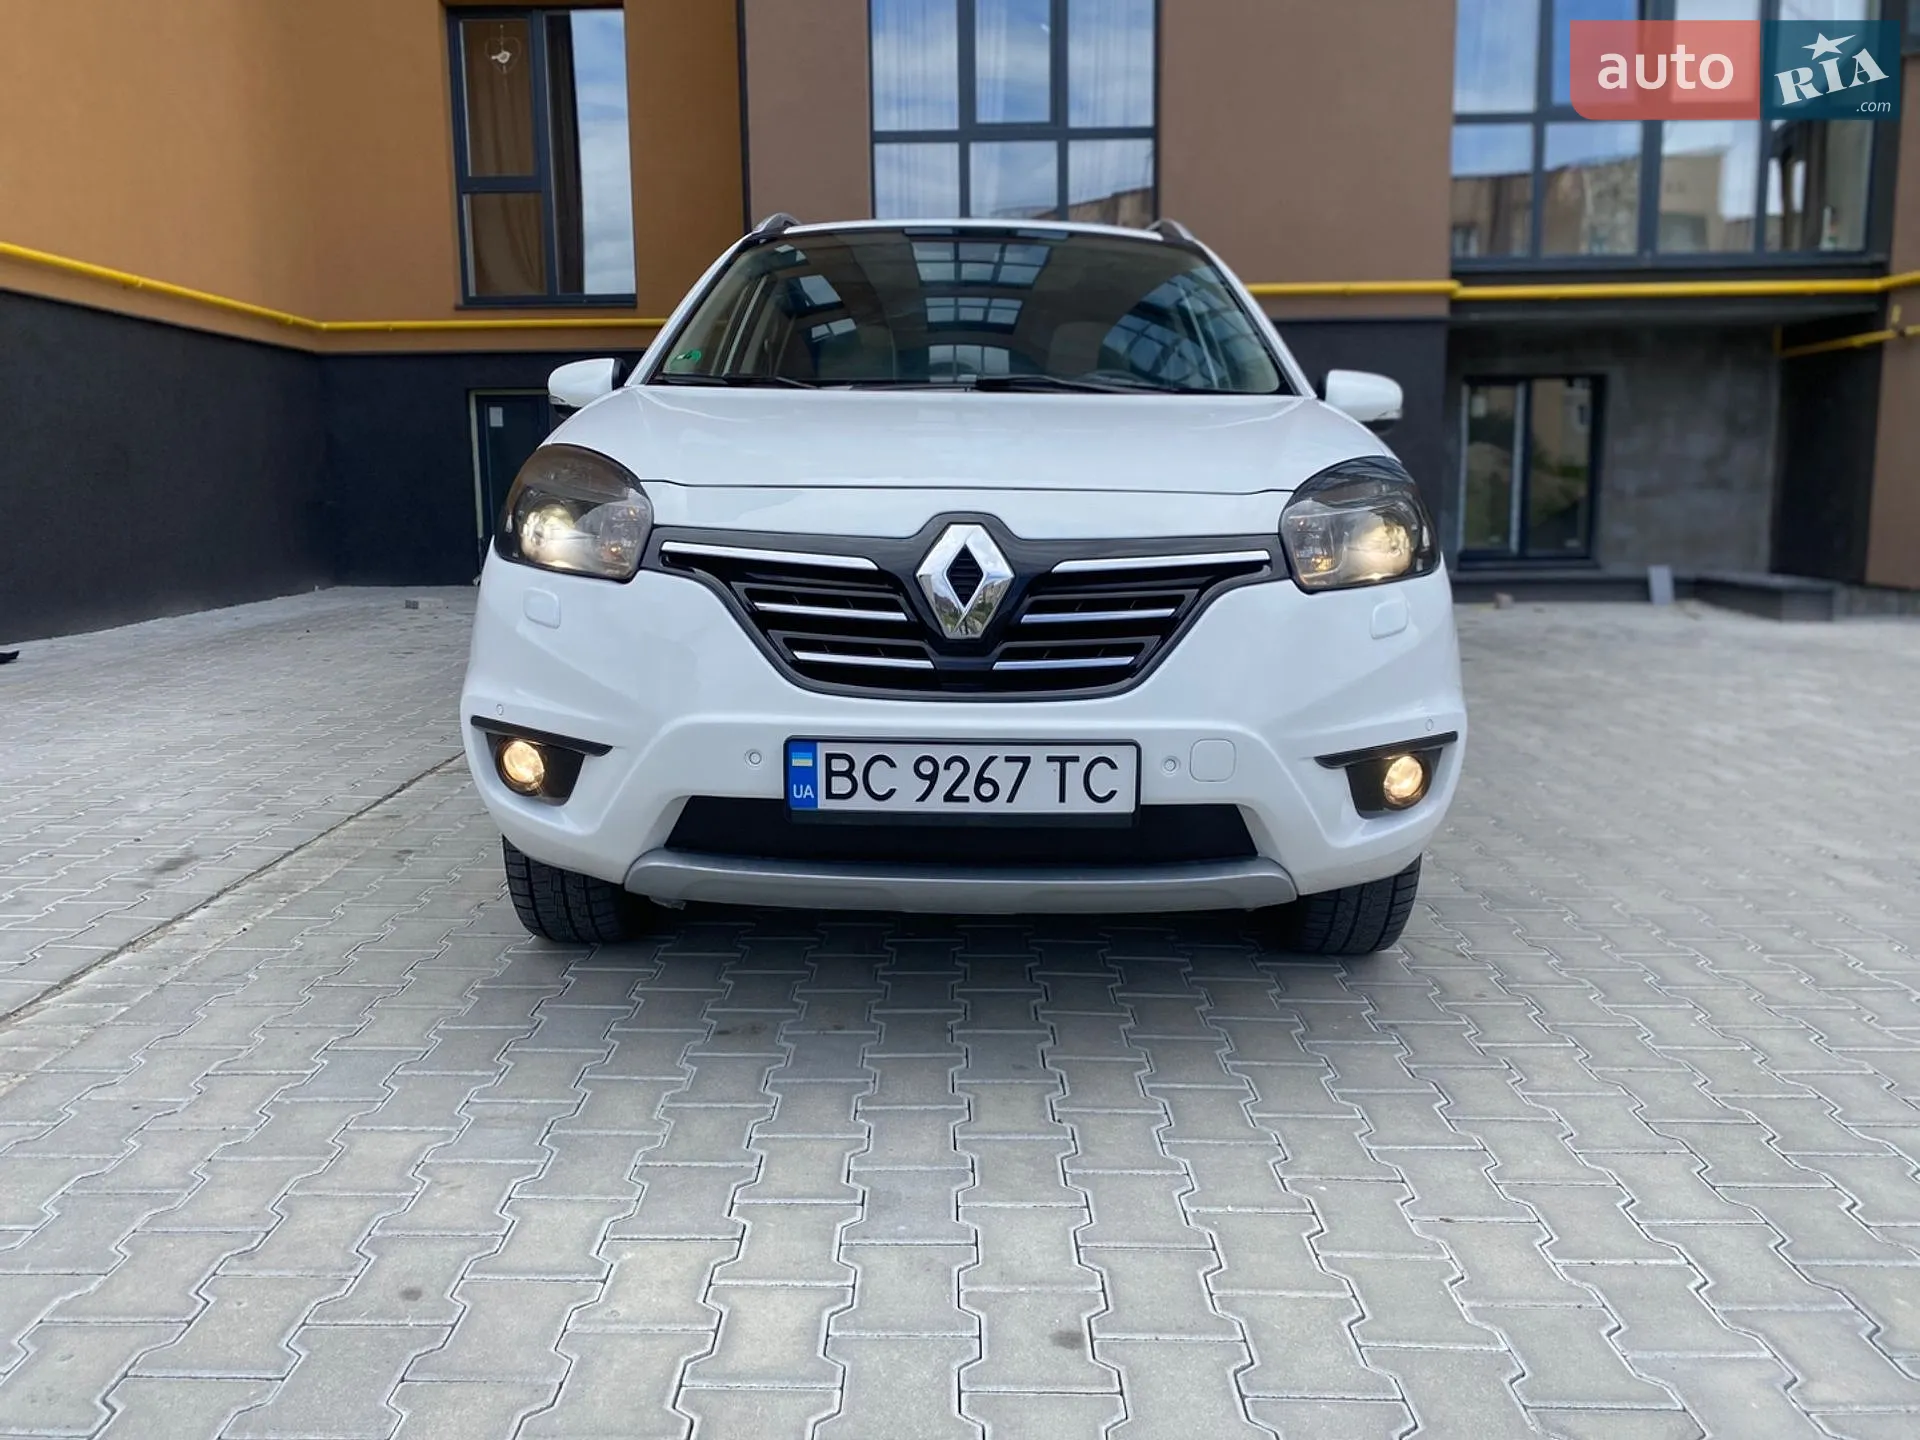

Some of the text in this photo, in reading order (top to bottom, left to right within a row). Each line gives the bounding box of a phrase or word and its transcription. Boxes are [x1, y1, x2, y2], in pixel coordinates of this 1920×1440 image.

[793, 784, 814, 799] UA
[824, 752, 1119, 803] BC 9267 TC
